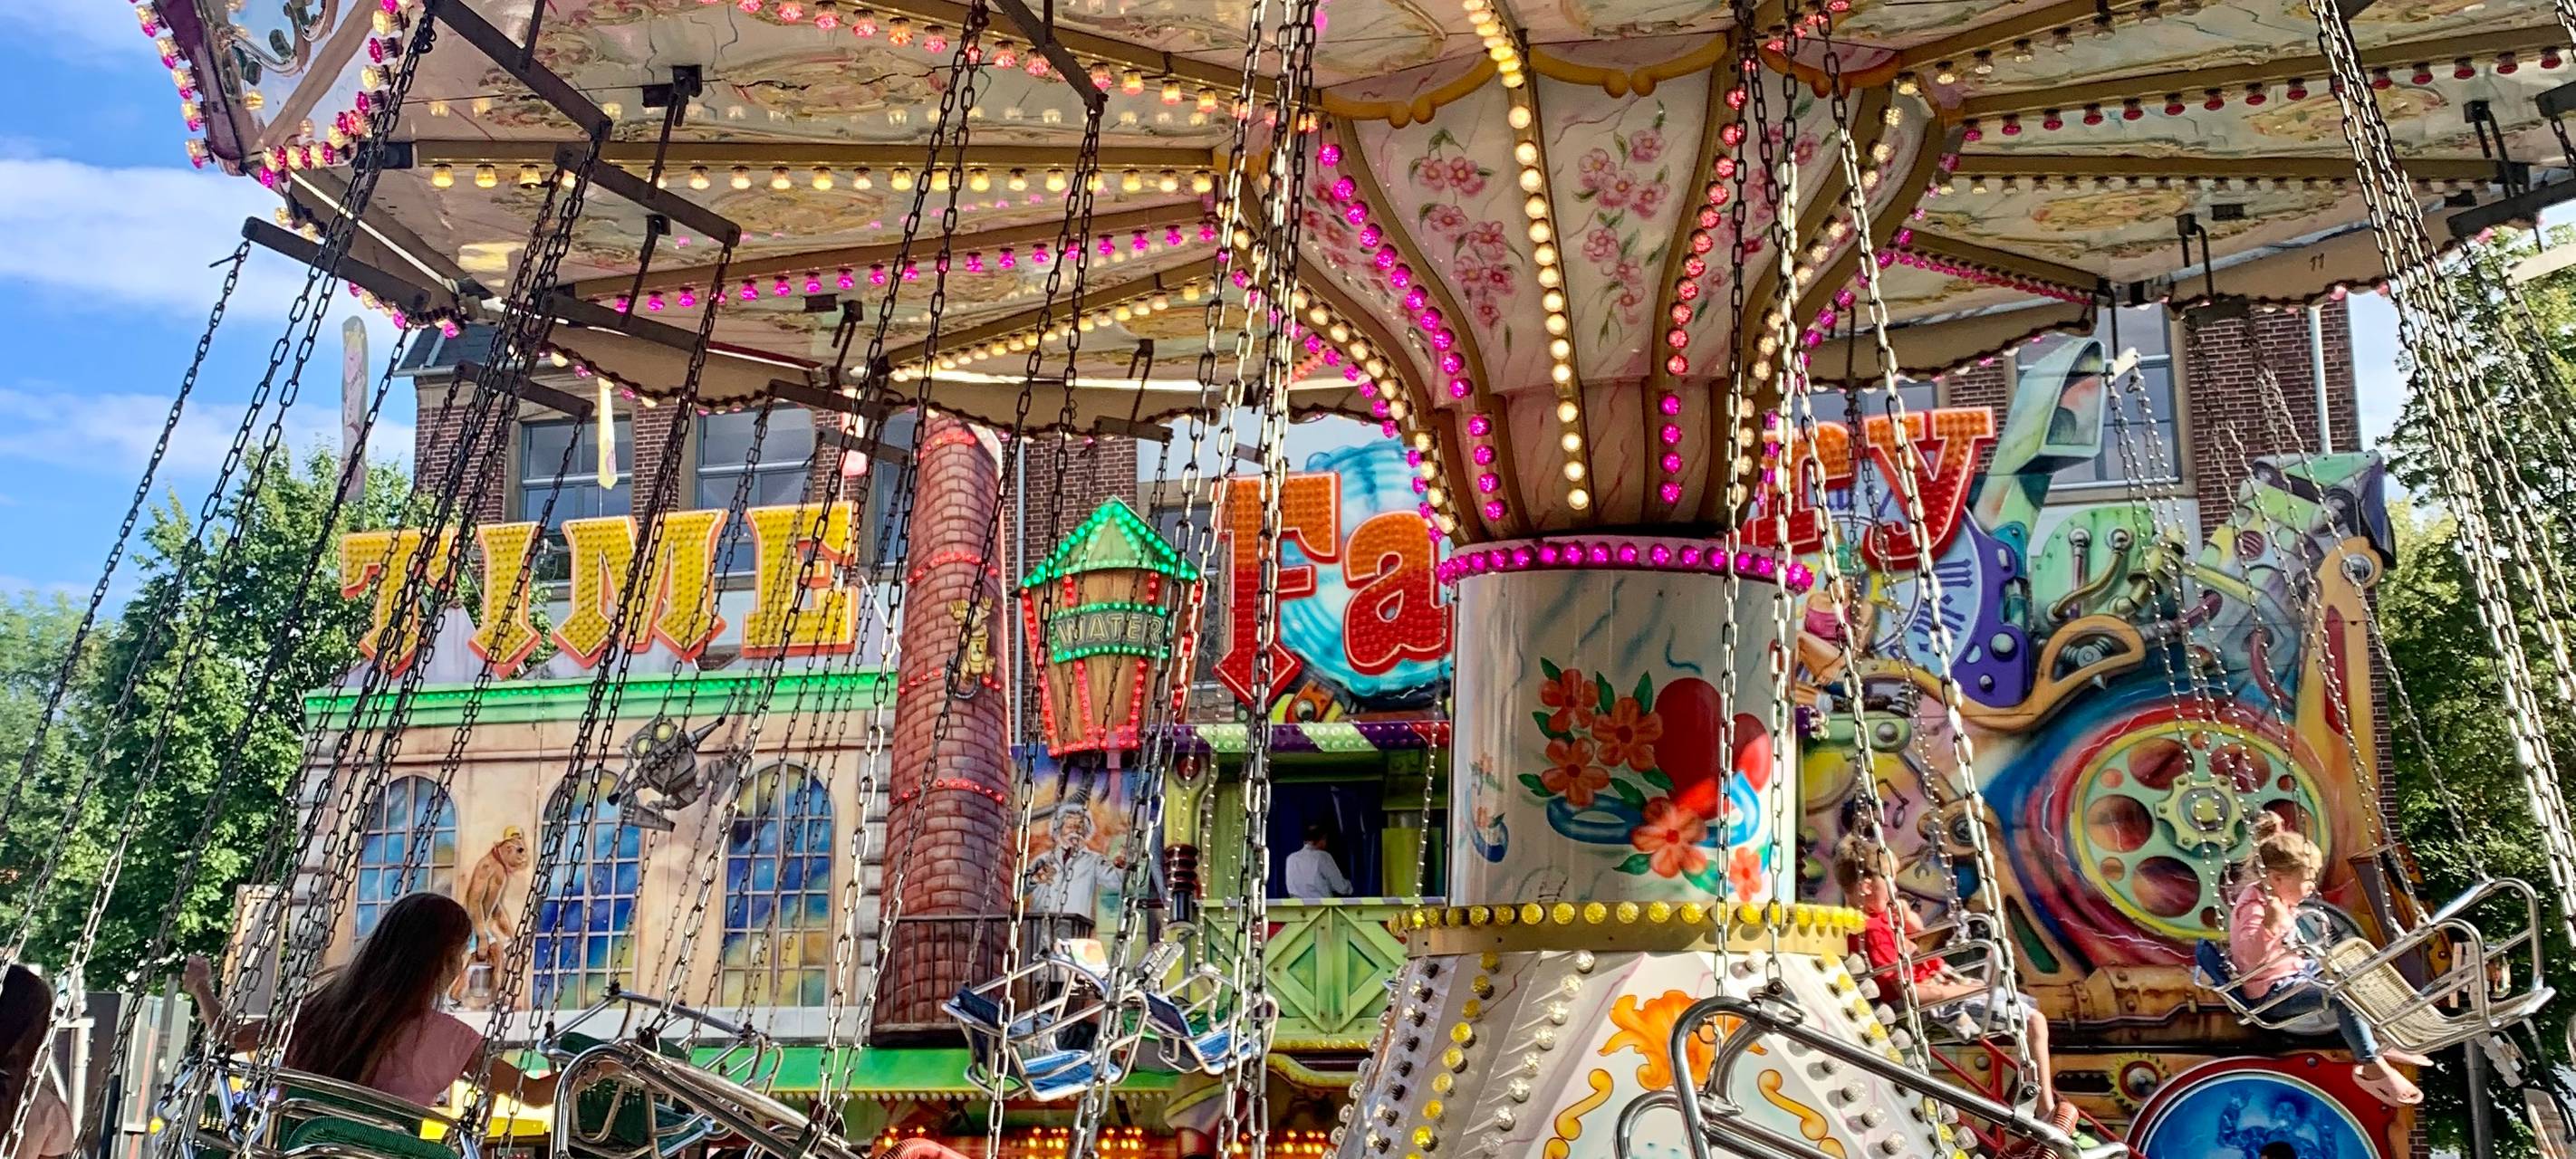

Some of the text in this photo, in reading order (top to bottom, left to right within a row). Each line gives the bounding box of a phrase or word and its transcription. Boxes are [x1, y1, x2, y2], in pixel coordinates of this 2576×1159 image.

[2309, 253, 2325, 272] 11
[341, 501, 859, 678] TIME
[1055, 612, 1165, 647] WATER
